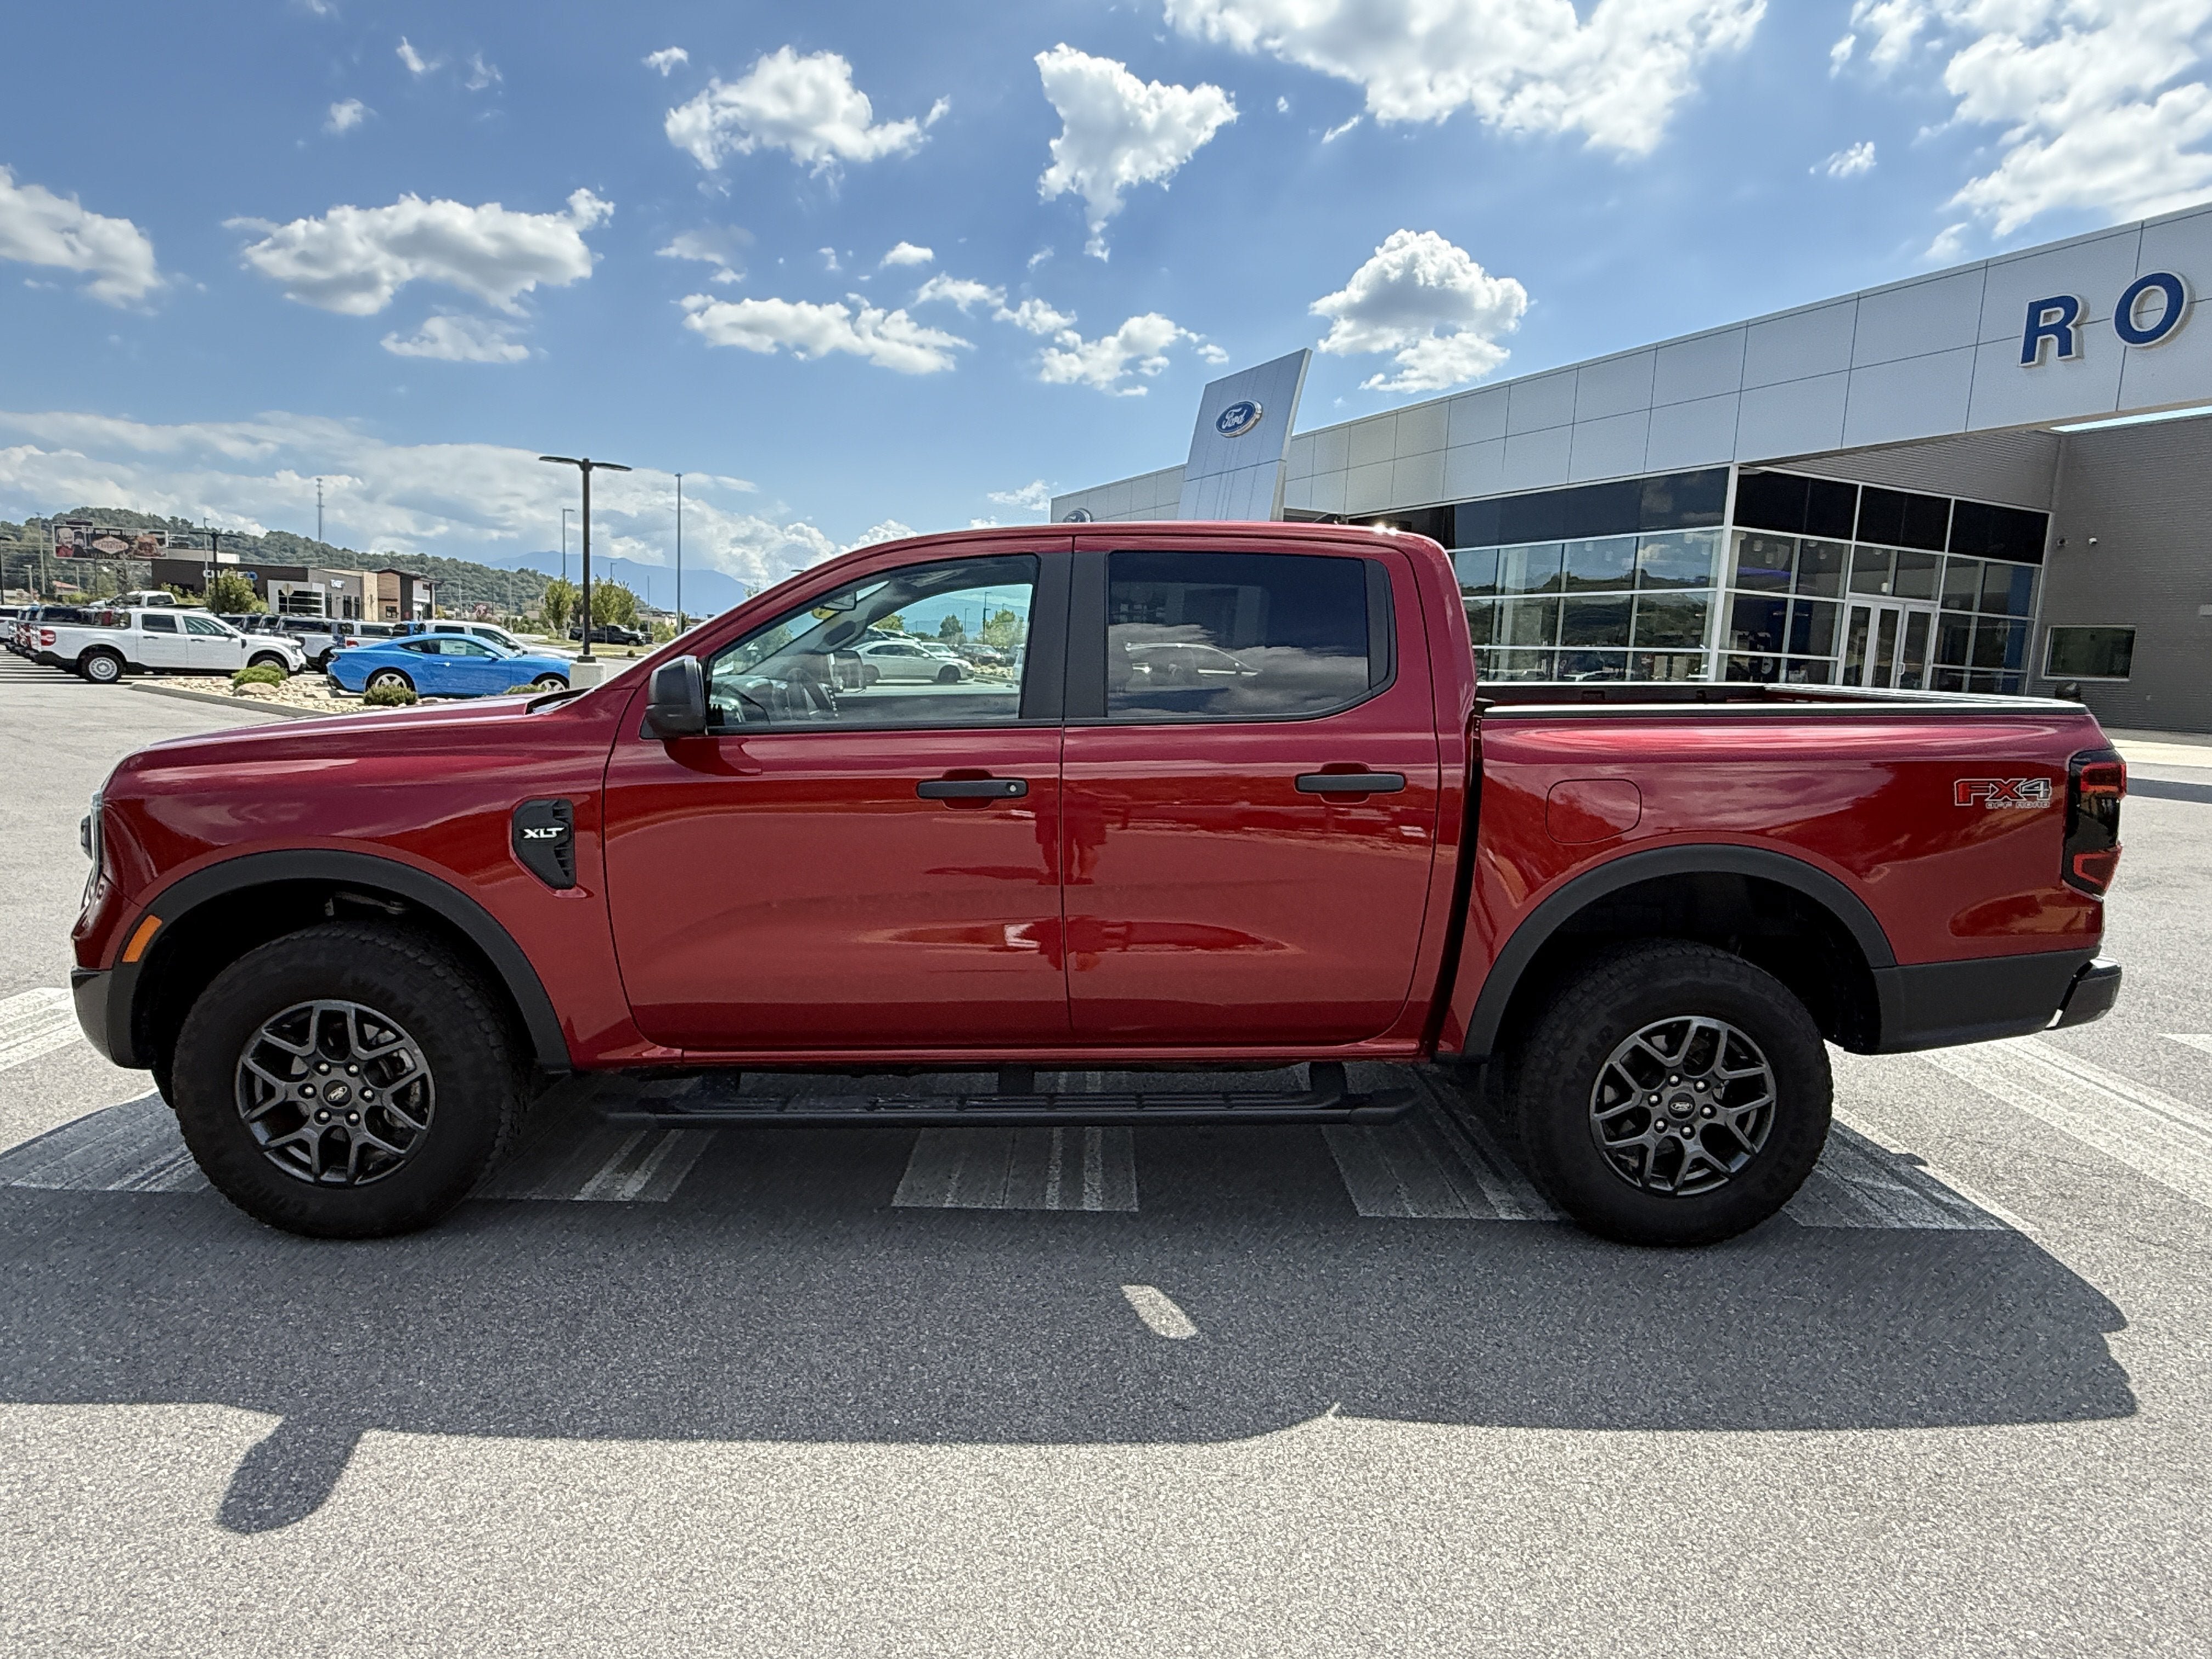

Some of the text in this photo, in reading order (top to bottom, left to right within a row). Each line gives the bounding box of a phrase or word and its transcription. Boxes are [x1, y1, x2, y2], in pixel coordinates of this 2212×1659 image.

[1221, 407, 1248, 429] Ford
[203, 569, 246, 579] CHE
[1954, 778, 2052, 806] FX4
[1985, 801, 2013, 809] OFF
[523, 827, 565, 839] XLT
